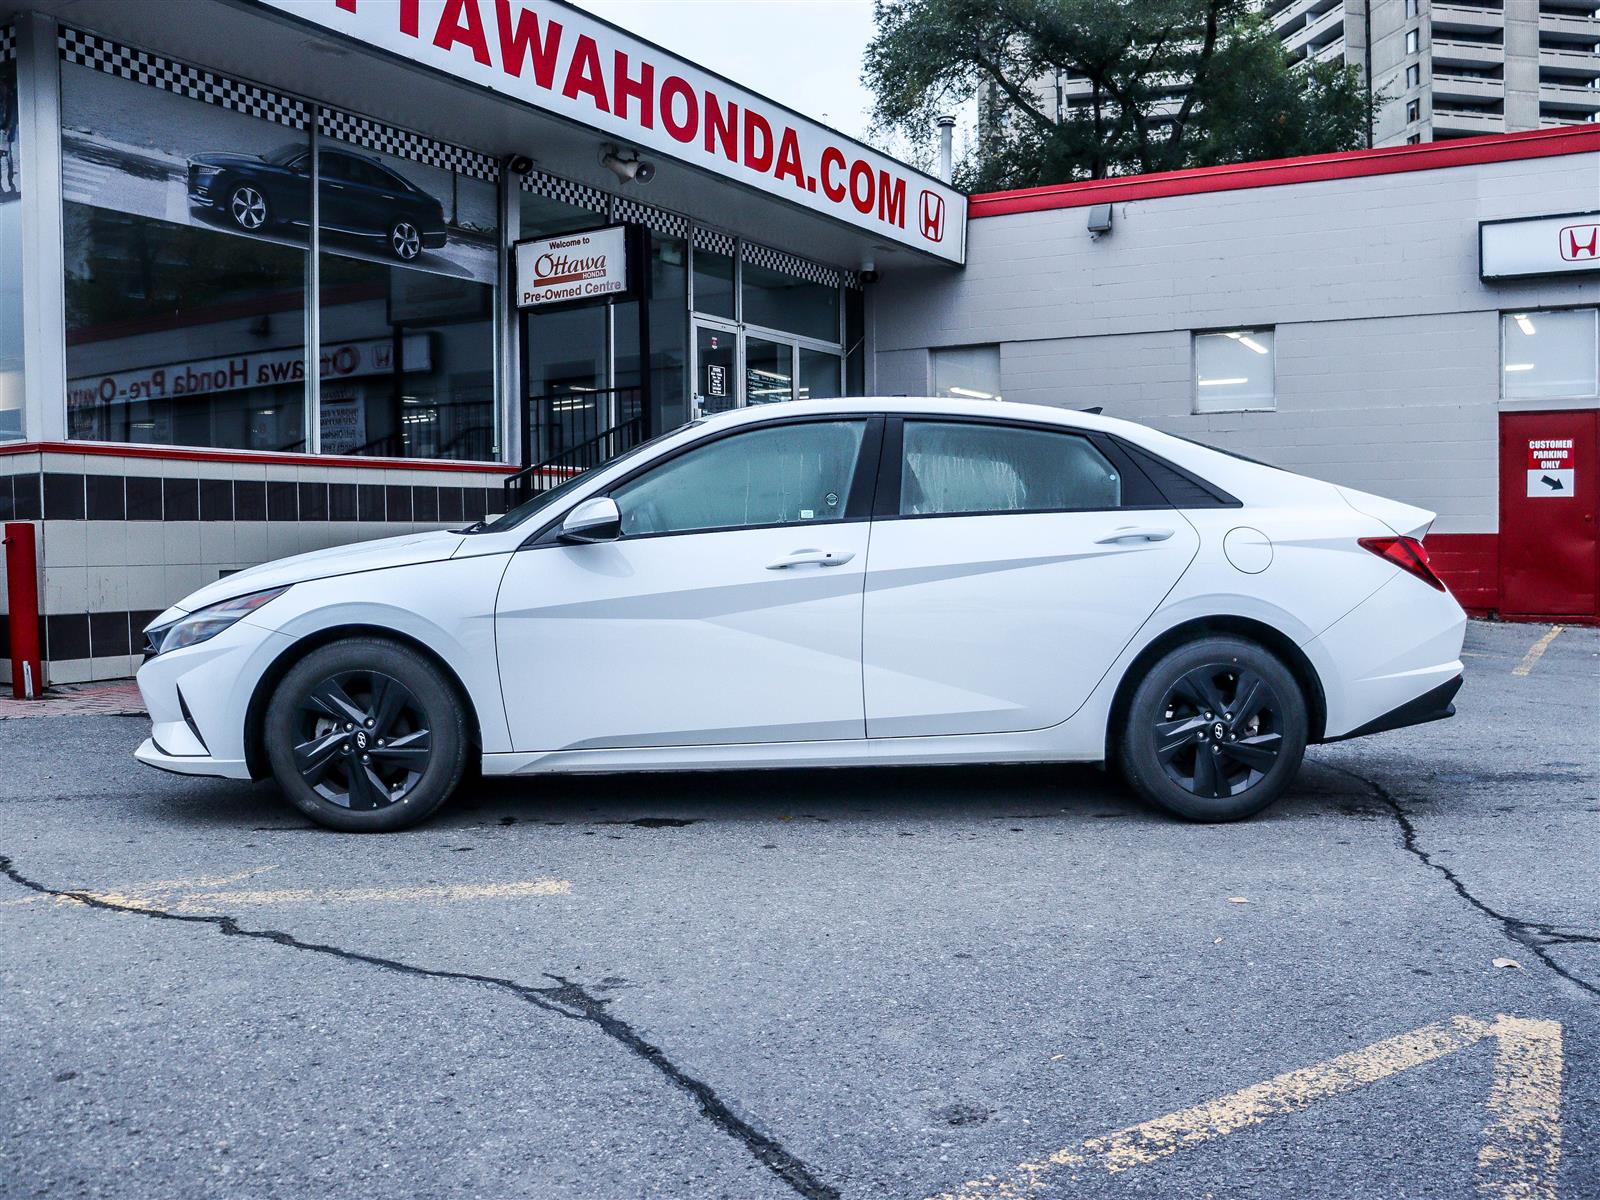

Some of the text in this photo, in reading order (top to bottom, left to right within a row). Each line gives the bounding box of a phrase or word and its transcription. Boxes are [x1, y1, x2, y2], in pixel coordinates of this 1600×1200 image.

[549, 236, 590, 250] Welcome to
[534, 253, 607, 278] Ottawa
[582, 270, 605, 280] HONDA
[523, 280, 621, 303] Pre-Owned Centre
[1529, 440, 1573, 449] CUSTOMER
[1533, 450, 1568, 459] PARKING
[1540, 460, 1560, 469] ONLY
